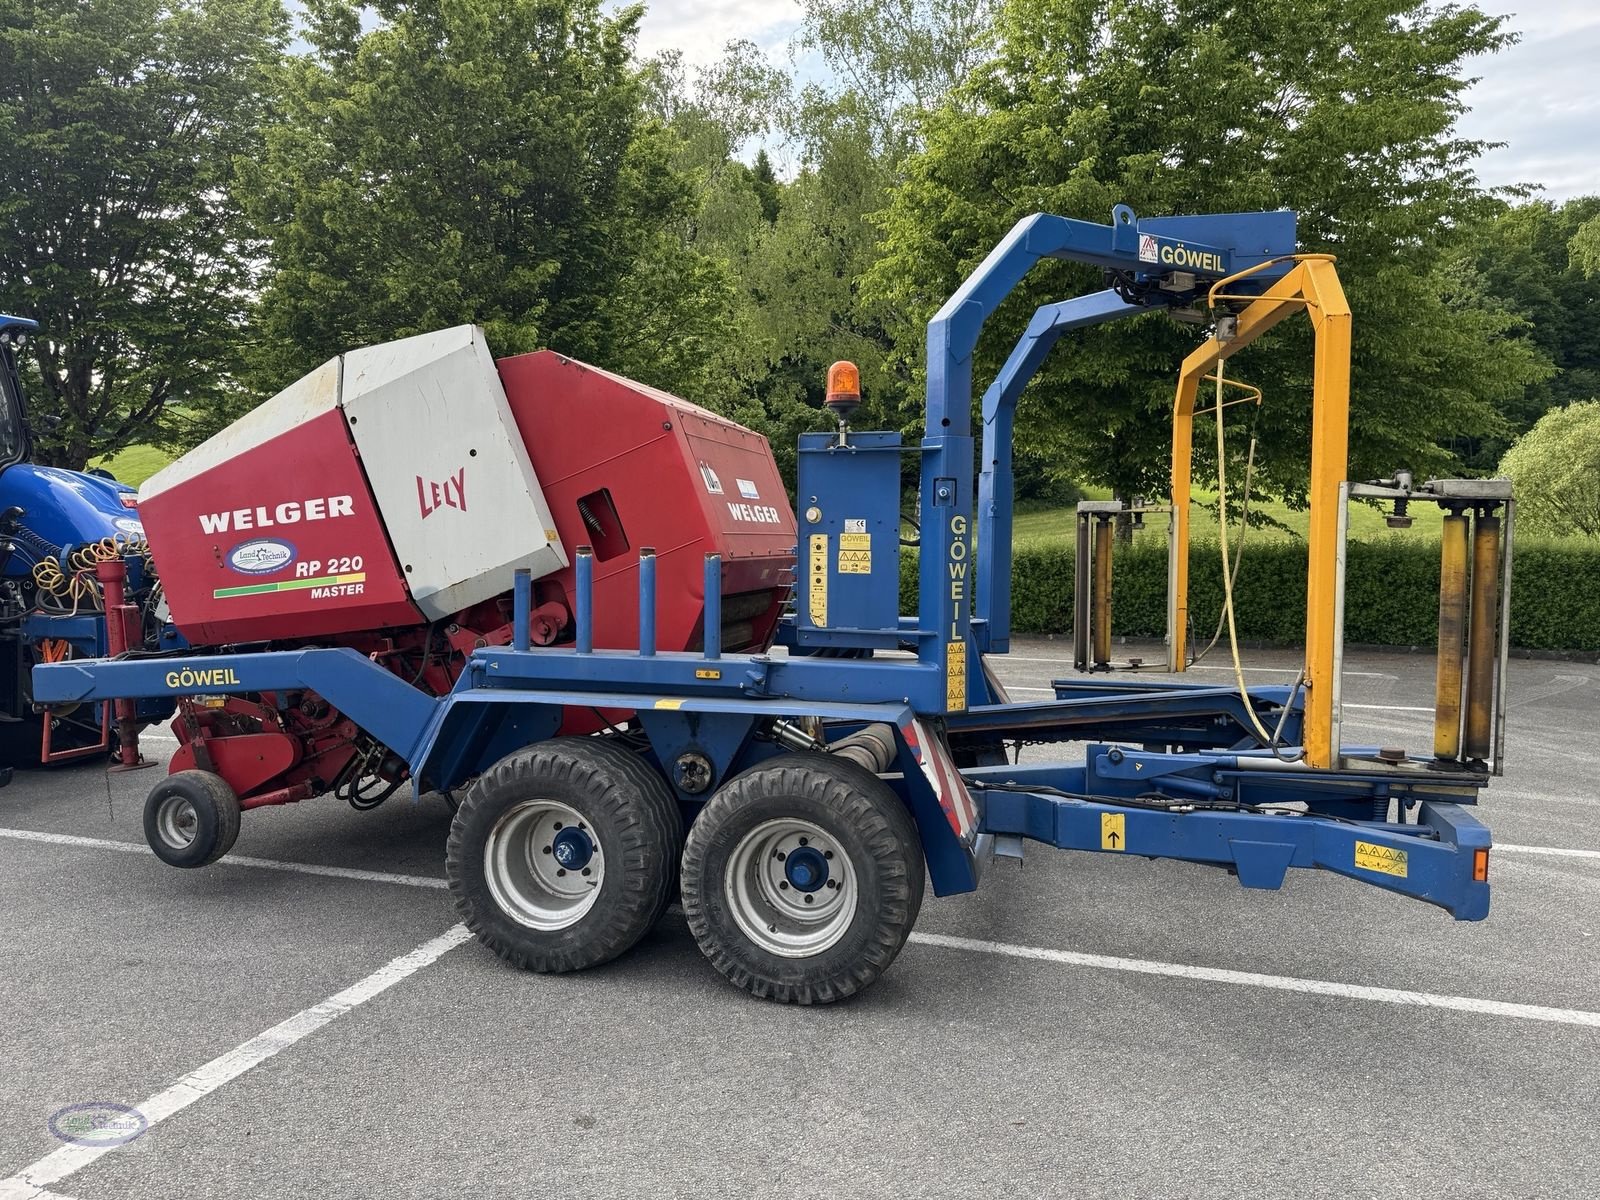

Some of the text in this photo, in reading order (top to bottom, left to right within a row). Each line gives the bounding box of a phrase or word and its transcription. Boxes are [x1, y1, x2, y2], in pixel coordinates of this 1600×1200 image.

[1161, 244, 1225, 272] GÖWEIL
[416, 467, 467, 520] LELY
[199, 495, 355, 534] WELGER
[727, 502, 781, 523] WELGER
[240, 550, 287, 560] Land Technik
[295, 561, 322, 578] RP
[327, 556, 363, 574] 220
[949, 515, 967, 640] GÖWEIL
[311, 583, 365, 599] MASTER
[165, 666, 240, 688] GÖWEIL
